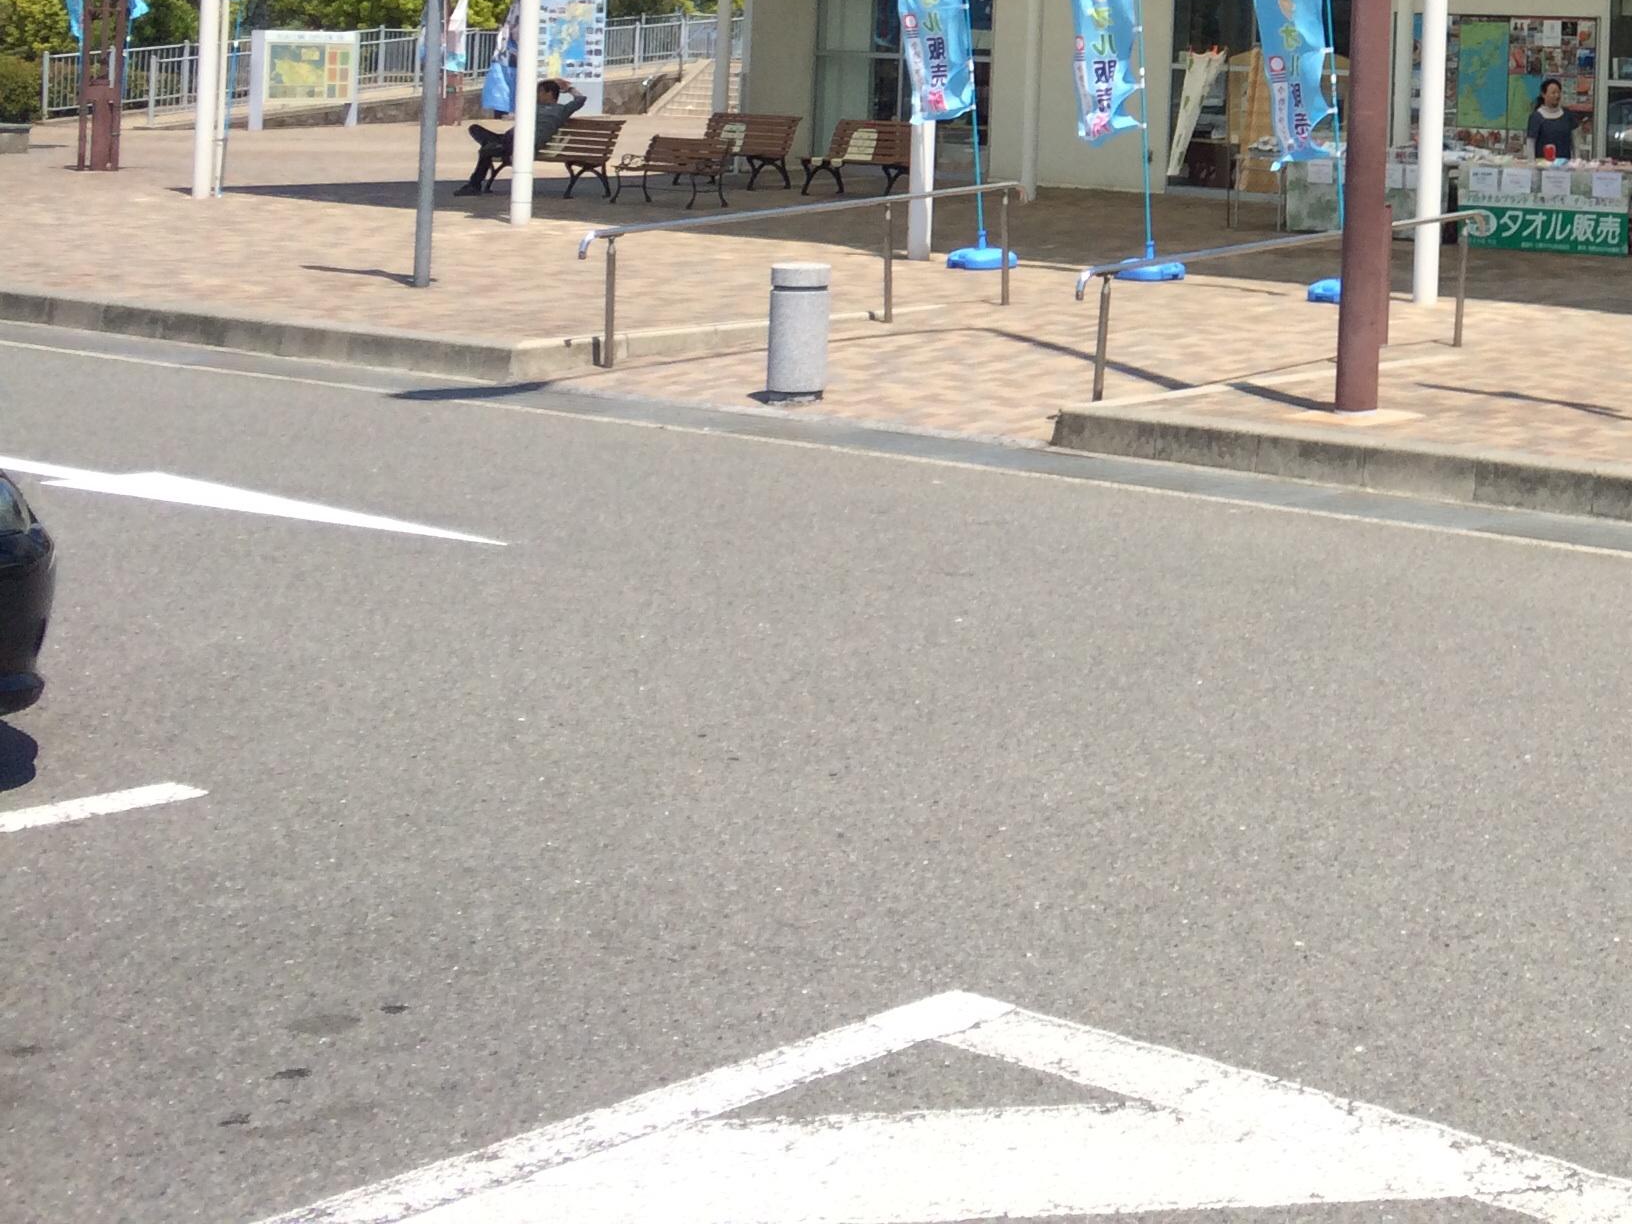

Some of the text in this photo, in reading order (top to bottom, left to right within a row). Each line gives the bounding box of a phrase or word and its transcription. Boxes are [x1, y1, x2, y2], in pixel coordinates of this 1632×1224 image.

[1500, 210, 1622, 245] タオル販売
